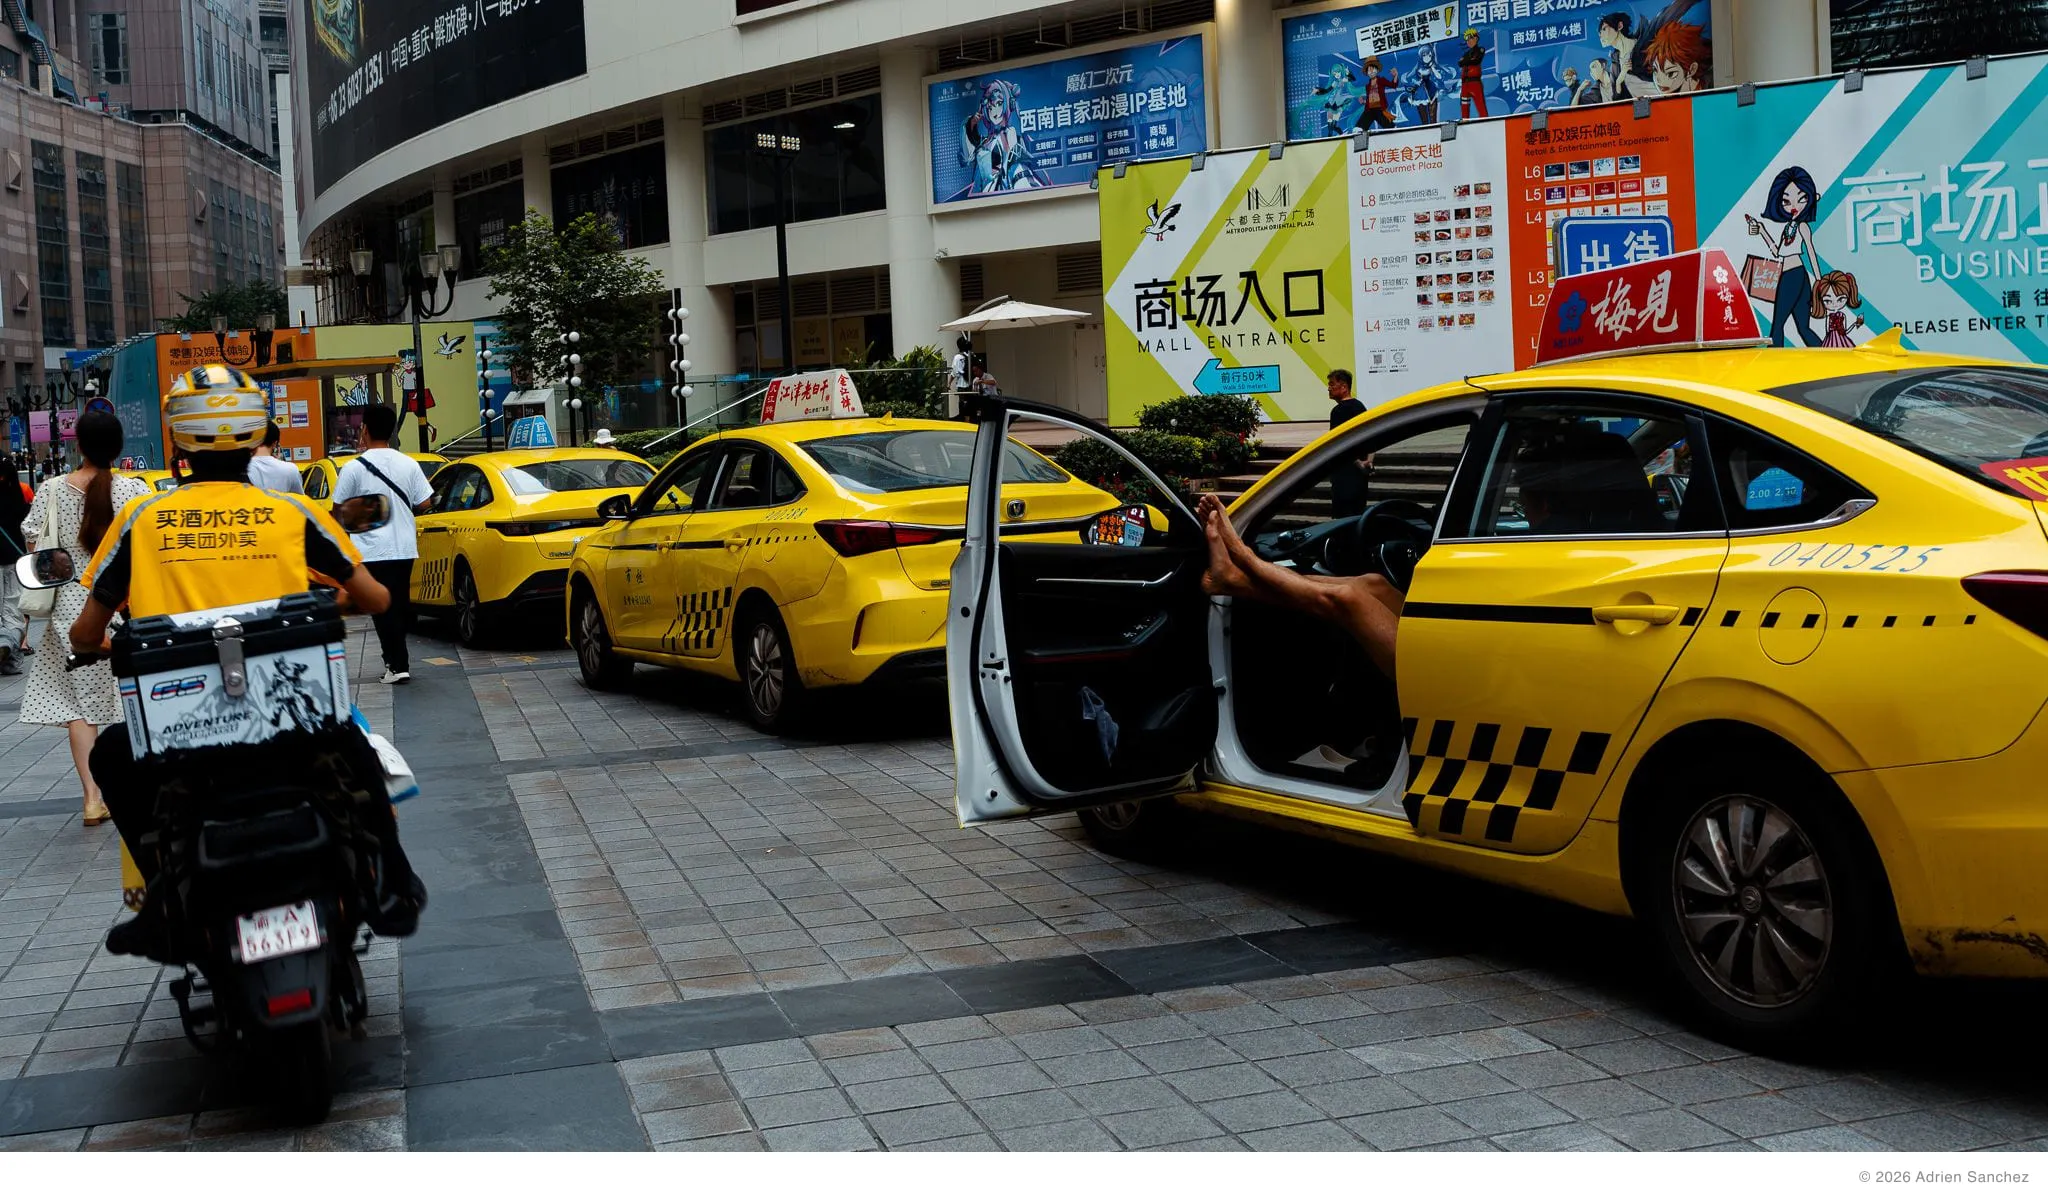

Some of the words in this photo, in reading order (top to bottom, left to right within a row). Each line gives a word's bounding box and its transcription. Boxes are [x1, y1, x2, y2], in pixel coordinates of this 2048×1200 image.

[1360, 10, 1441, 42] 二次元动漫基地
[1513, 22, 1582, 45] 商场1楼/4楼
[1373, 25, 1431, 54] 空降重庆
[339, 82, 346, 117] 23
[346, 66, 362, 110] 6037
[365, 51, 384, 95] 1351
[1066, 64, 1134, 93] 魔幻二次元
[1502, 70, 1531, 92] 引爆
[1516, 85, 1554, 102] 次元力
[1019, 81, 1188, 133] 西南首家动漫IP基地
[1149, 124, 1168, 136] 商场
[1525, 121, 1621, 146] 零售及娱乐体验
[1143, 136, 1175, 150] 1楼/4楼
[1525, 147, 1547, 156] Retail
[1558, 140, 1616, 152] Entertainment
[1618, 134, 1669, 147] Experiences
[1359, 143, 1442, 166] 山城美食天地
[1360, 167, 1375, 178] CQ
[1377, 163, 1416, 175] Gourmet
[1418, 160, 1443, 171] Plaza
[1525, 165, 1541, 179] L6
[1361, 194, 1376, 208] L8
[1525, 188, 1542, 202] L5
[1226, 208, 1315, 228] 大都会东方广场
[1226, 225, 1267, 234] METROPOLITAN
[1268, 222, 1295, 231] ORIENTAL
[1297, 221, 1315, 229] PLAZA
[1361, 217, 1377, 231] L7
[1526, 211, 1543, 225] L4
[1363, 257, 1379, 270] L6
[1916, 245, 2048, 283] BUSINE
[1364, 280, 1380, 293] L5
[1528, 271, 1545, 284] L3
[1134, 269, 1325, 333] 商场入口
[1529, 294, 1545, 307] L2
[1365, 320, 1381, 332] L4
[1968, 315, 2027, 332] ENTER
[1138, 337, 1192, 353] MALL
[1208, 328, 1326, 350] ENTRANCE
[1531, 337, 1538, 349] L
[1221, 370, 1266, 384] 前行50米
[780, 379, 829, 407] 江津老白干
[1749, 488, 1770, 499] 2.00
[155, 506, 276, 530] 买酒水冷饮
[158, 530, 258, 552] 上美团外卖
[1768, 541, 1943, 573] 040525
[162, 711, 253, 735] ADVENTURE
